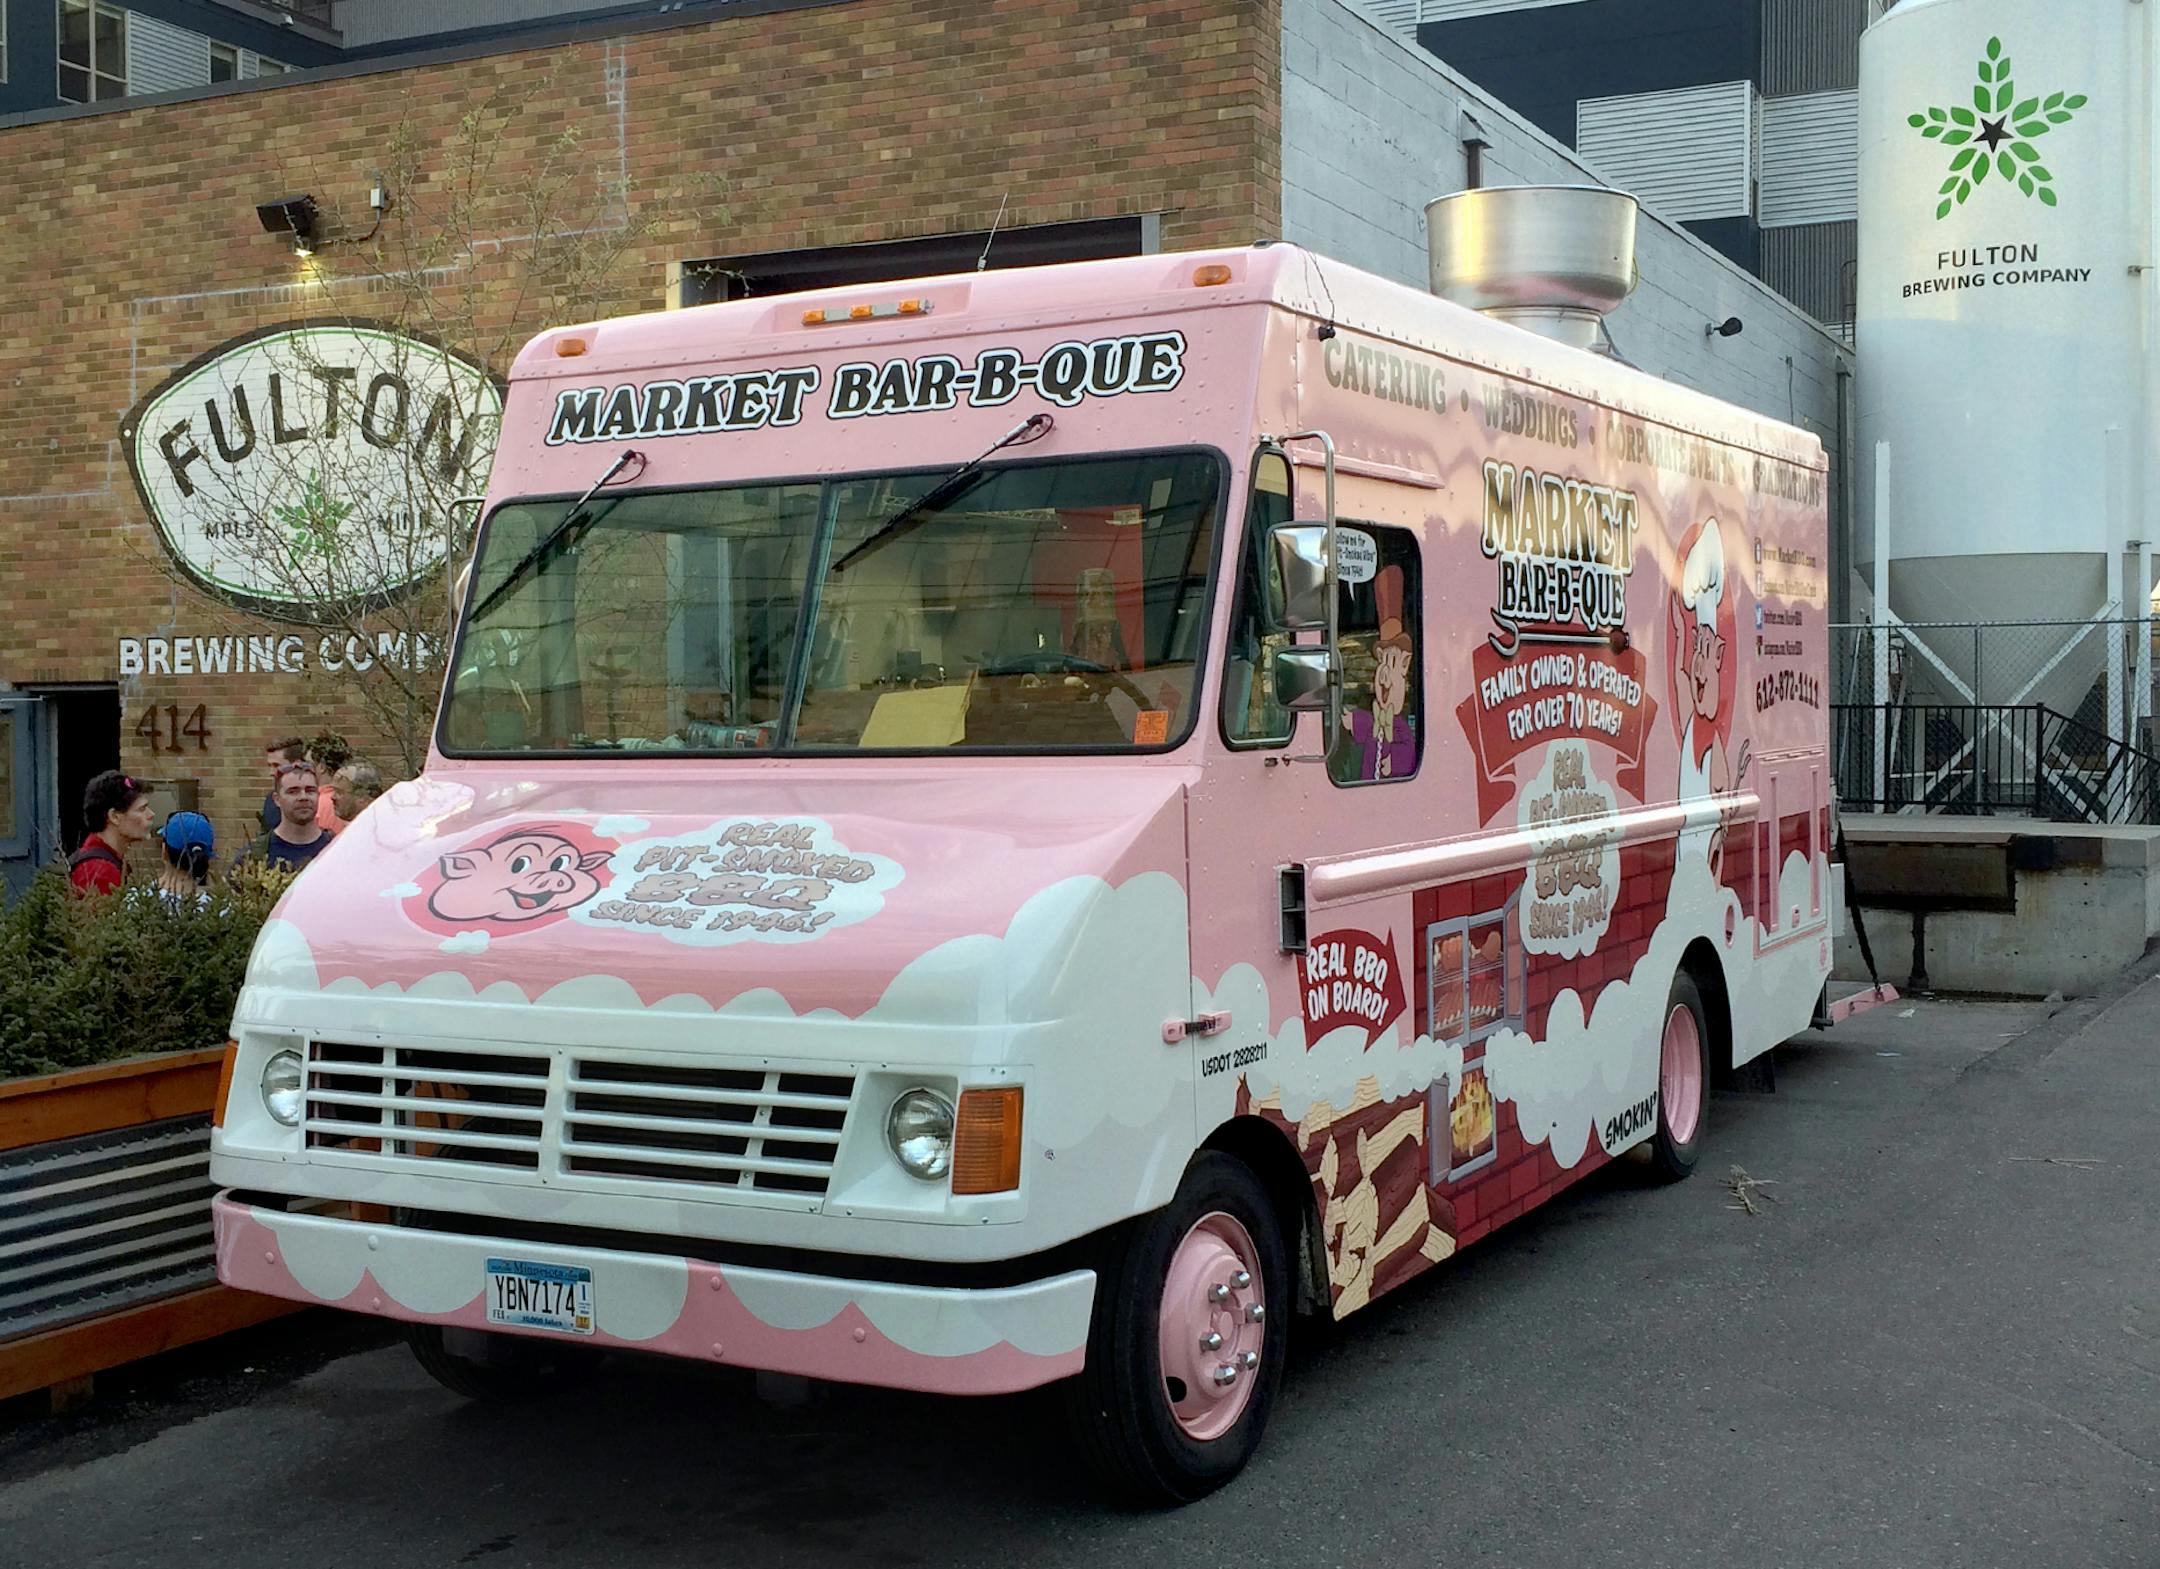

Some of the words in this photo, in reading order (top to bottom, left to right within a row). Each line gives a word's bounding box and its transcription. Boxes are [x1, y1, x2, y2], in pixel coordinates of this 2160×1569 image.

[1938, 244, 2038, 270] FULTON
[1902, 274, 1985, 298] BREWING
[1993, 268, 2091, 286] COMPANY
[545, 364, 820, 447] MARKET
[828, 331, 1187, 420] BAR-B-QUE
[1324, 337, 1447, 415] CATERING
[1482, 383, 1579, 449] WEDDINGS
[158, 367, 476, 498] FULTON
[1482, 457, 1640, 577] MARKET
[1499, 554, 1626, 632] BAR-B-QUE
[118, 634, 305, 675] BREWING
[1480, 663, 1528, 711] FAMILY
[1530, 653, 1574, 690] OWNED
[1577, 653, 1588, 689] &
[1589, 660, 1642, 708] OPERATED
[136, 703, 212, 757] 414
[1506, 702, 1534, 741] FOR
[1533, 694, 1565, 731] OVER
[1566, 692, 1585, 729] 70
[1586, 697, 1624, 738] YEARS!
[717, 822, 816, 850] REAL
[633, 845, 876, 883] PIT-SMOKED
[625, 872, 834, 912] BBQ
[589, 899, 706, 929] SINCE
[705, 910, 836, 933] 1946!
[1528, 900, 1570, 940] SINCE
[1306, 942, 1348, 984] REAL
[1353, 945, 1388, 992] BBQ
[1307, 983, 1330, 1022] ON
[1331, 980, 1389, 1027] BOARD!
[1201, 1051, 1231, 1077] USDOT
[1605, 1090, 1657, 1151] SMOKIN'
[513, 1260, 564, 1278] Minnesota
[495, 1274, 576, 1318] YBN7174
